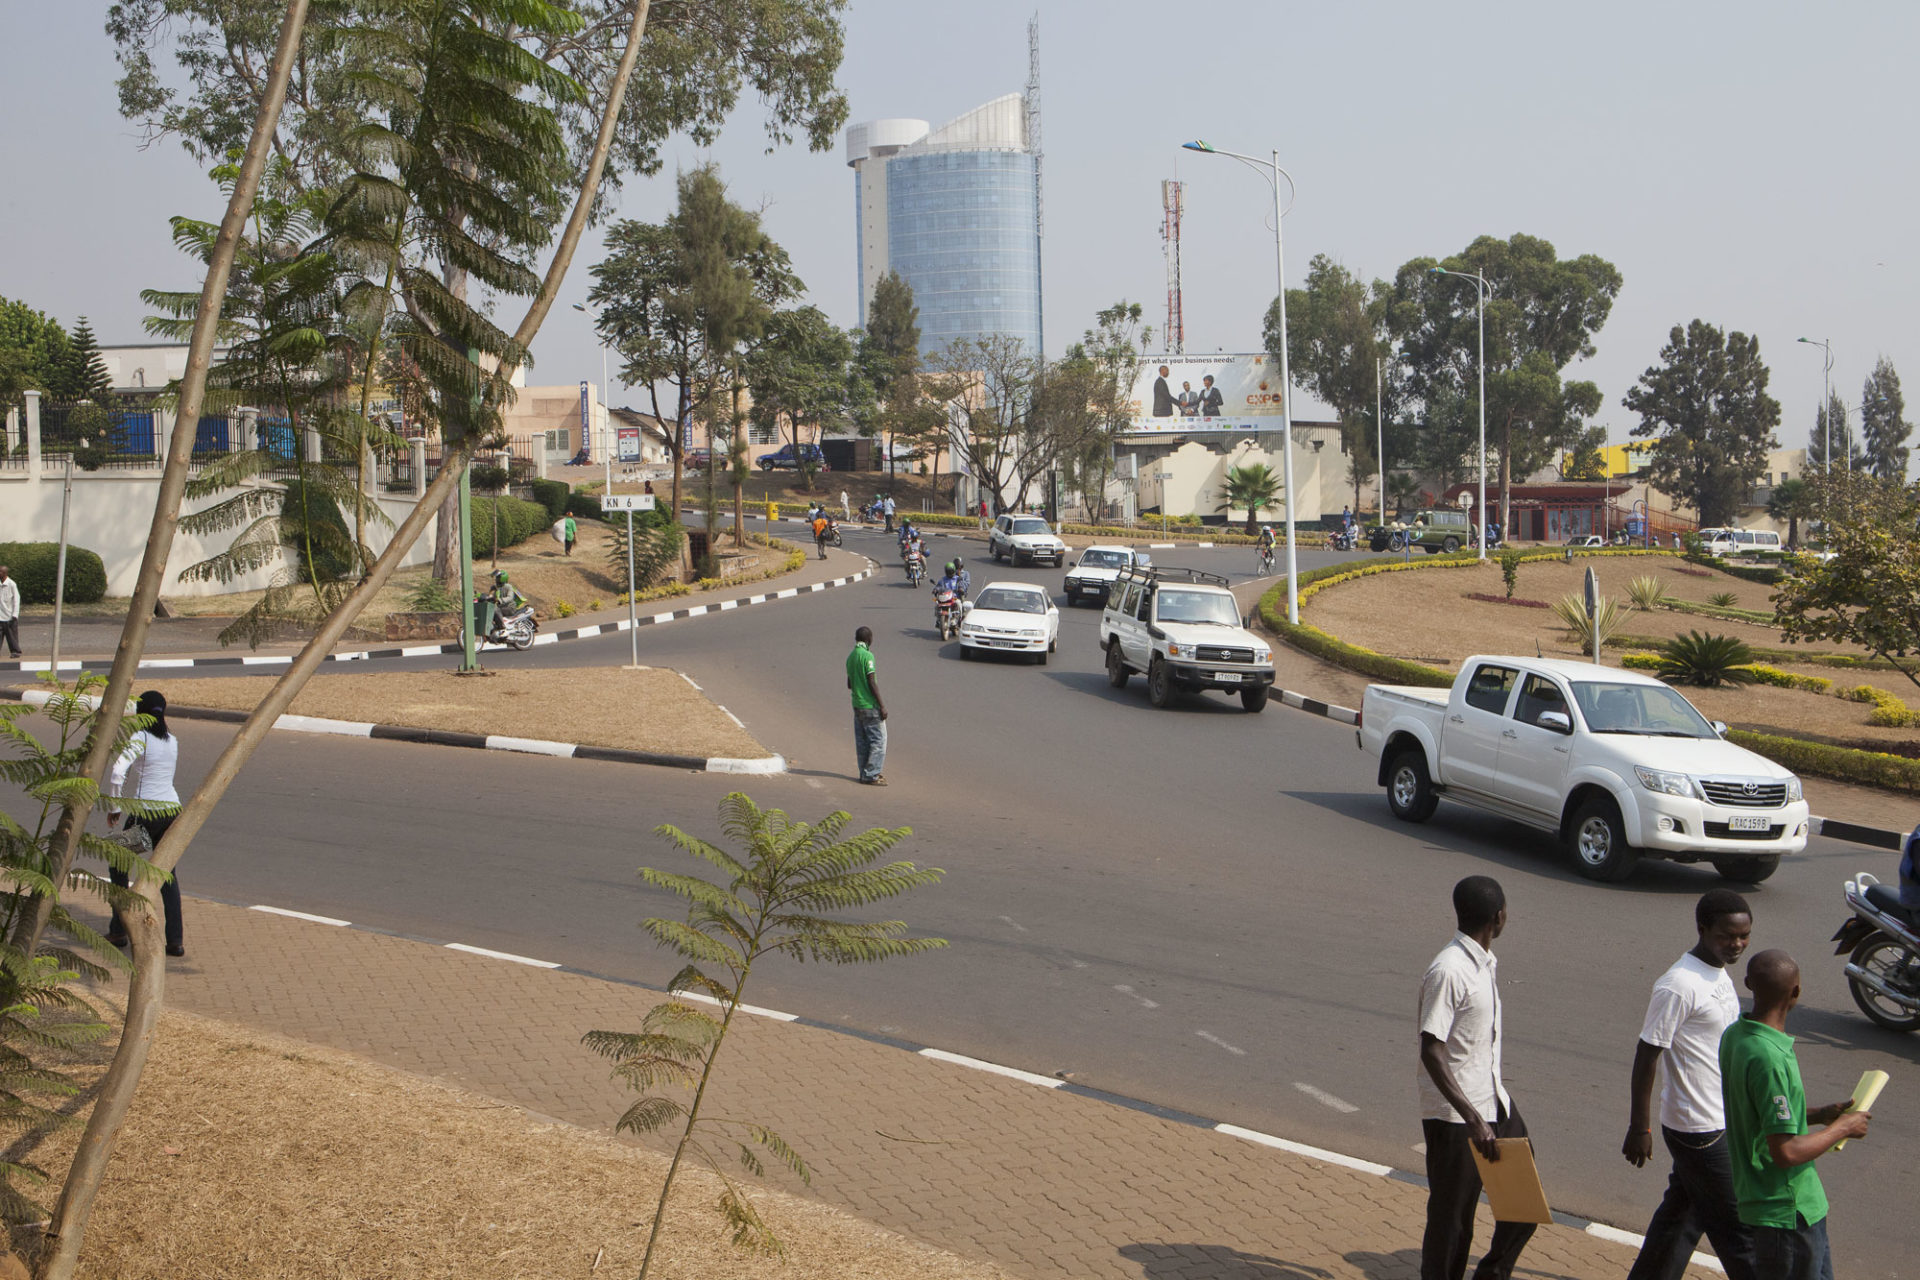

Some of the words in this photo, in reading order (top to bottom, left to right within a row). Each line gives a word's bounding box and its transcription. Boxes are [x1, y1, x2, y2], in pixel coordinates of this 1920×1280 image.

[1151, 356, 1169, 364] what
[1185, 356, 1212, 364] business
[1213, 356, 1236, 364] needs!
[1246, 393, 1282, 406] EXPO
[606, 497, 619, 508] KN
[626, 497, 632, 508] 6
[1734, 817, 1767, 829] RAC159B
[1773, 1095, 1791, 1120] 3
